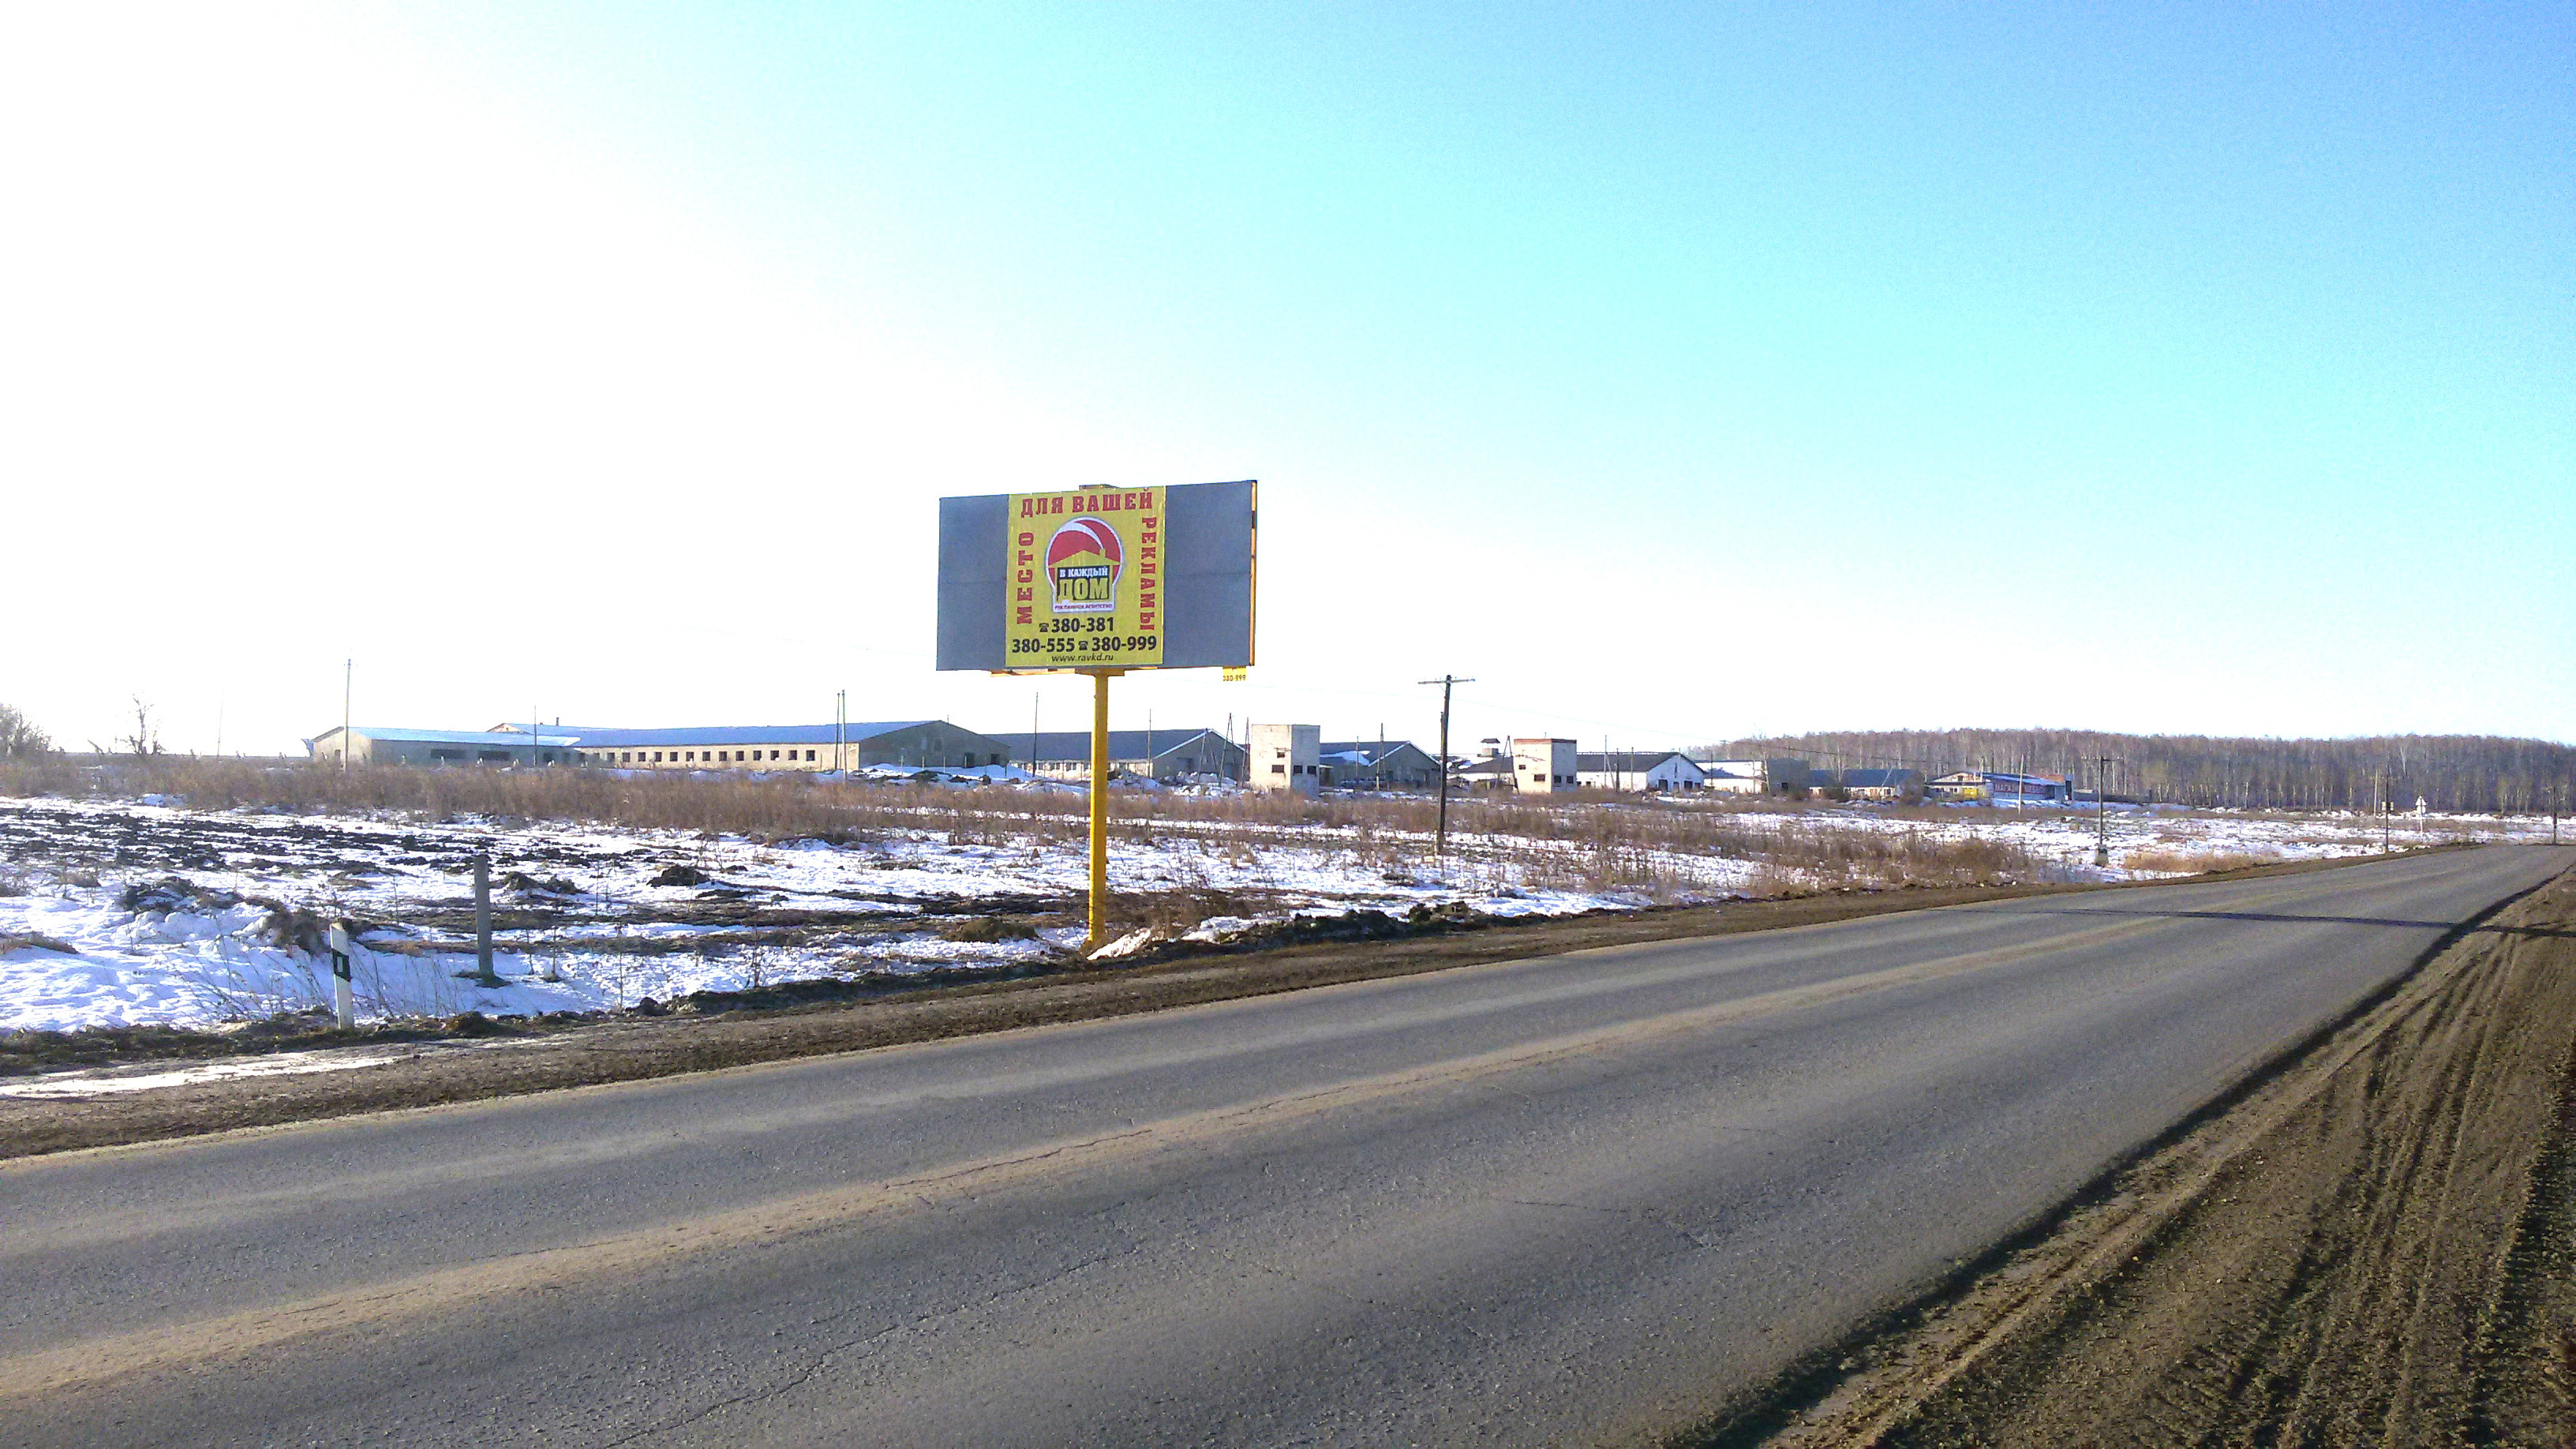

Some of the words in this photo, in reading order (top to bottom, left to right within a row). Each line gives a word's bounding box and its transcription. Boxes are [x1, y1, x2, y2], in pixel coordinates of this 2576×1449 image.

[1020, 496, 1063, 519] ДЛЯ
[1072, 487, 1152, 513] ВАШЕЙ
[1017, 532, 1035, 624] МЕСТО
[1068, 566, 1108, 578] КАЖДЫЙ
[1140, 517, 1157, 631] РЕКЛАМЫ
[1058, 577, 1108, 601] ДОМ
[1051, 616, 1114, 633] 380-381
[1012, 638, 1075, 653] 380-555
[1091, 635, 1157, 652] 380-999
[1051, 653, 1114, 662] www.ravkd.ru
